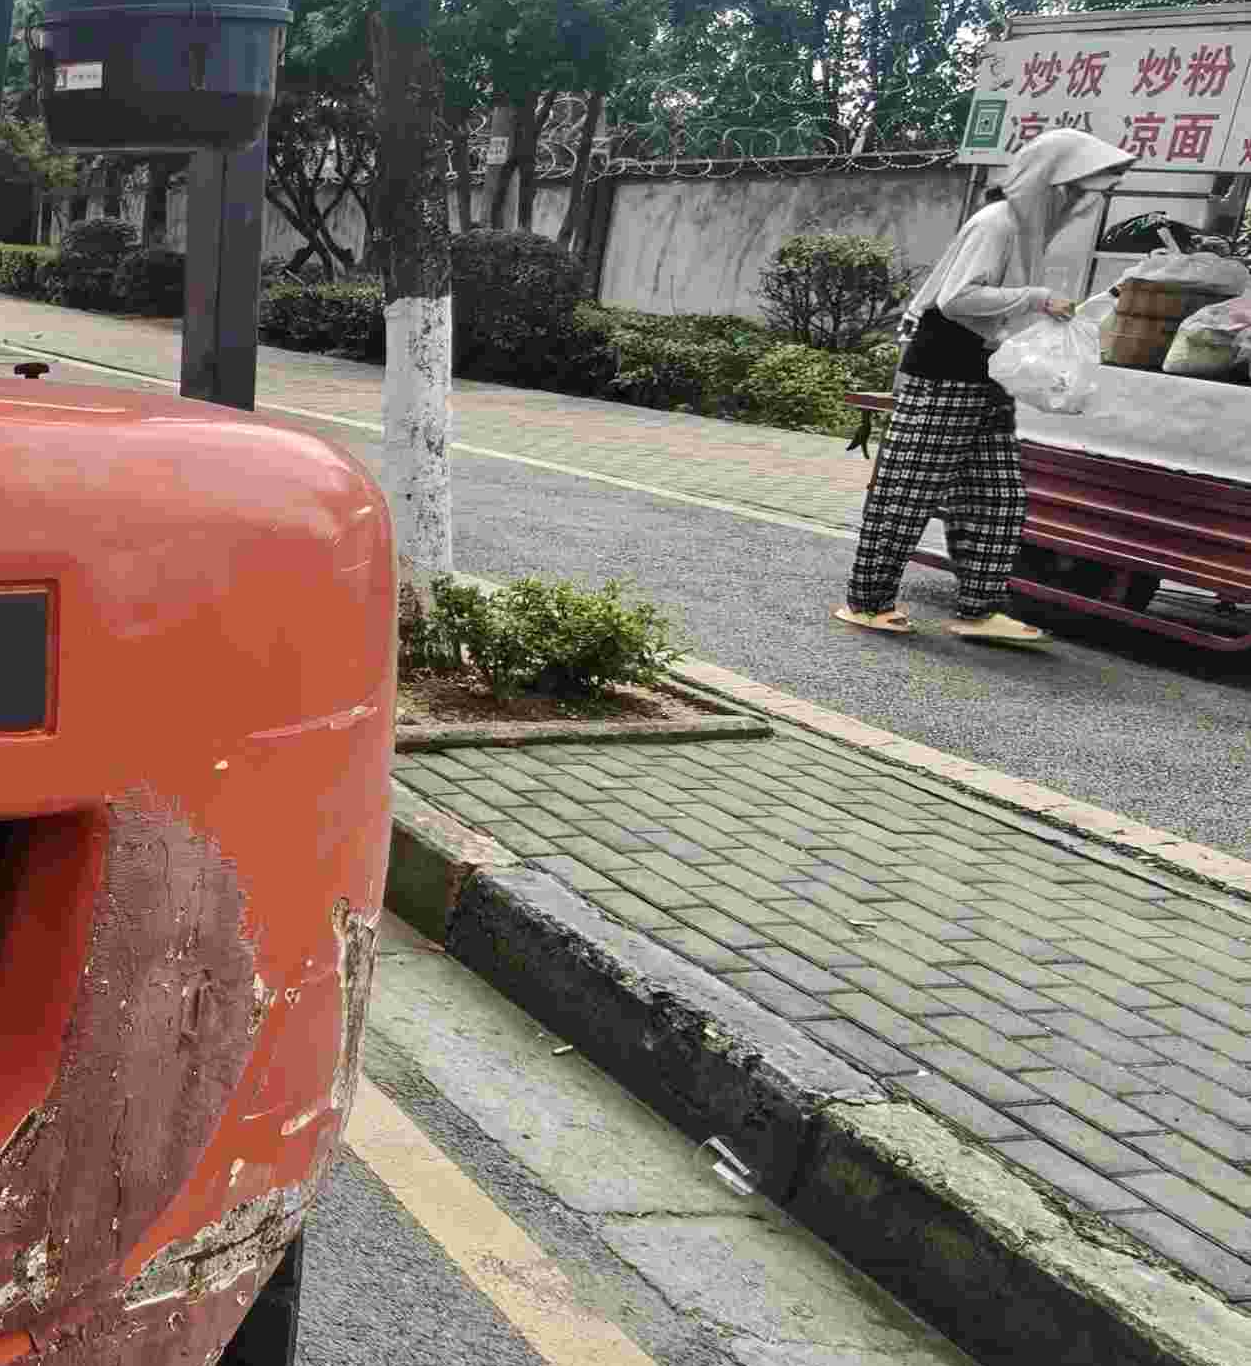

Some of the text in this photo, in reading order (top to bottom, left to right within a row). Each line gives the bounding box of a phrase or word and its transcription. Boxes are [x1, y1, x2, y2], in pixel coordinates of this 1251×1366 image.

[1017, 44, 1236, 98] 炒饭 炒粉
[1118, 112, 1220, 163] 凉面
